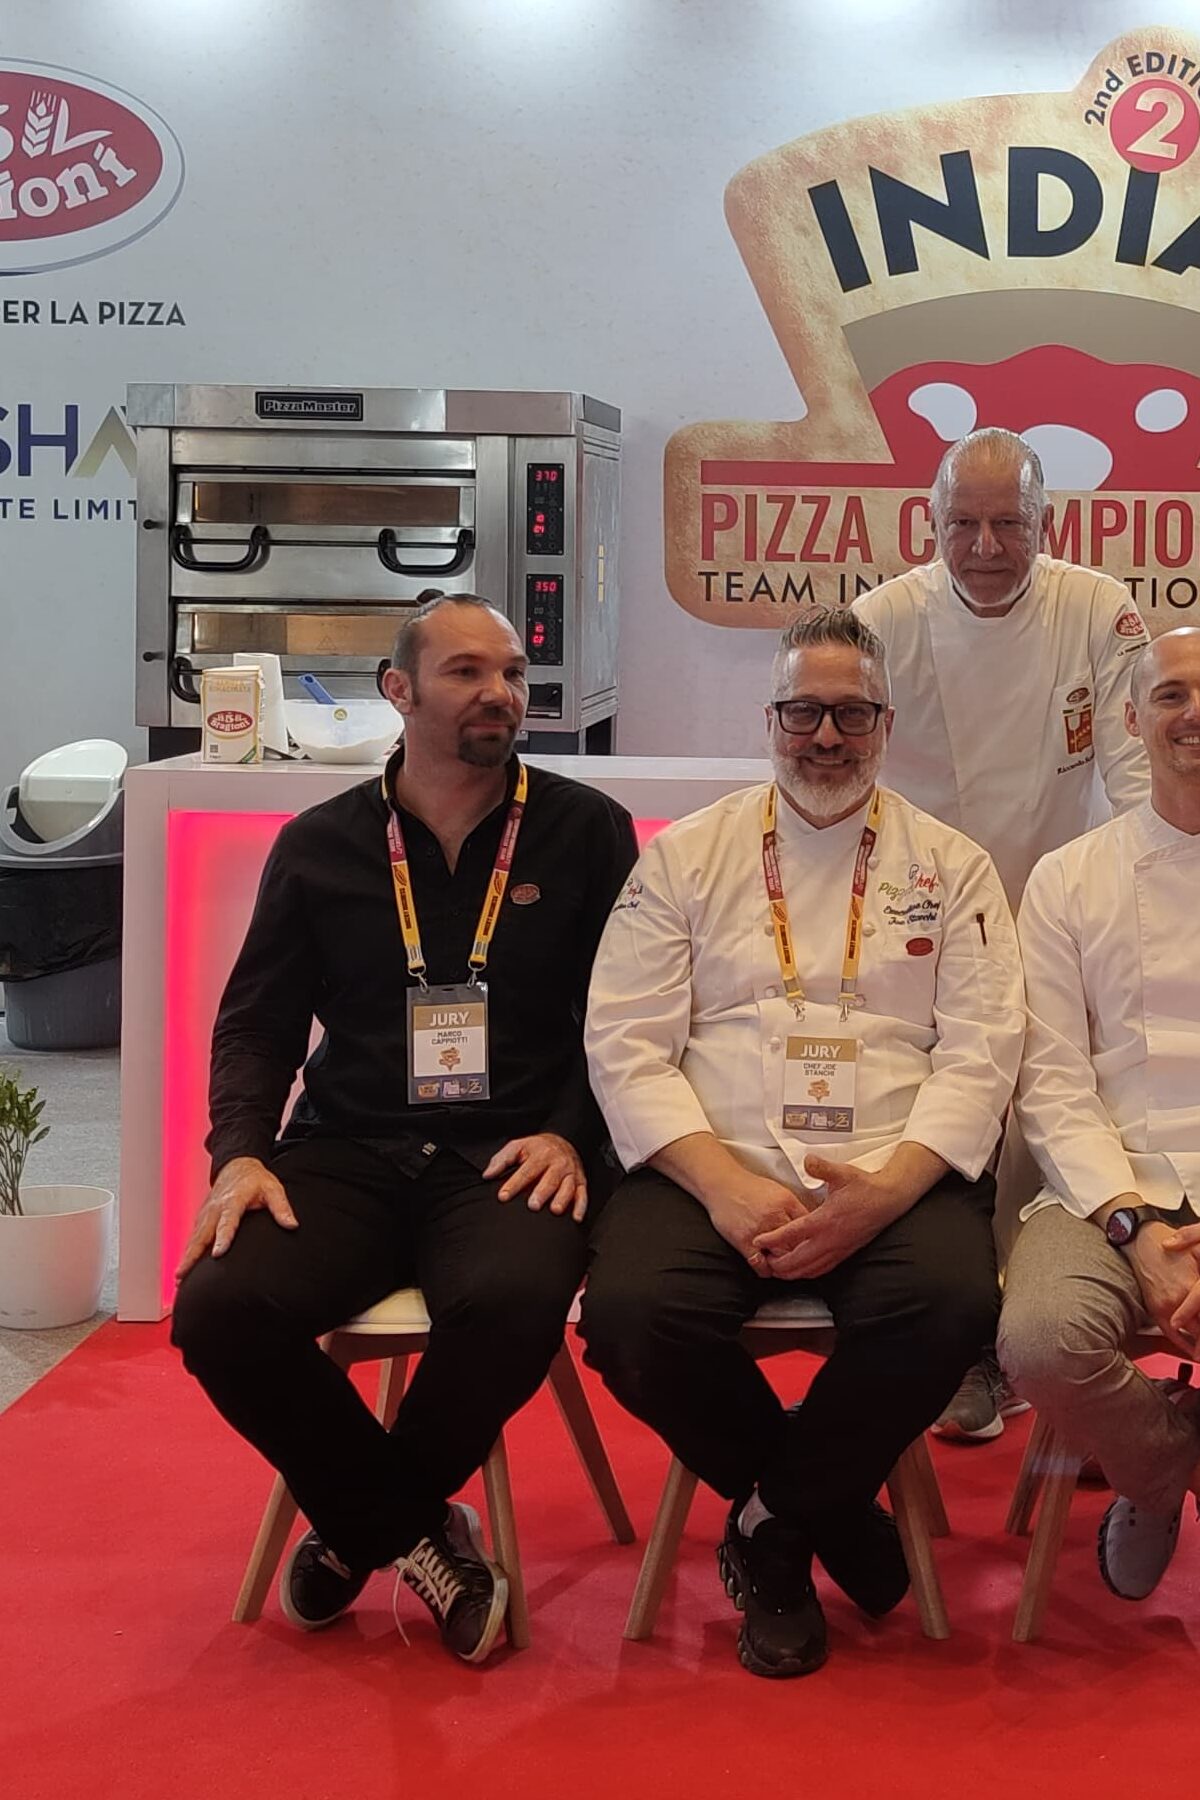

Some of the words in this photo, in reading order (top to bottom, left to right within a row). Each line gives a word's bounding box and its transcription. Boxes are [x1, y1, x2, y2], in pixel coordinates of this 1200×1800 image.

[1084, 68, 1124, 127] 2nd
[1126, 87, 1185, 160] 2
[51, 301, 89, 324] LA
[99, 302, 187, 326] PIZZA
[535, 470, 559, 482] 370
[701, 493, 874, 564] PIZZA
[535, 581, 557, 593] 350
[698, 571, 816, 603] TEAM
[429, 1011, 470, 1027] JURY
[437, 1030, 462, 1038] MARCO
[800, 1044, 841, 1058] JURY
[803, 1062, 821, 1070] CHEF
[804, 1069, 835, 1077] STANCHI
